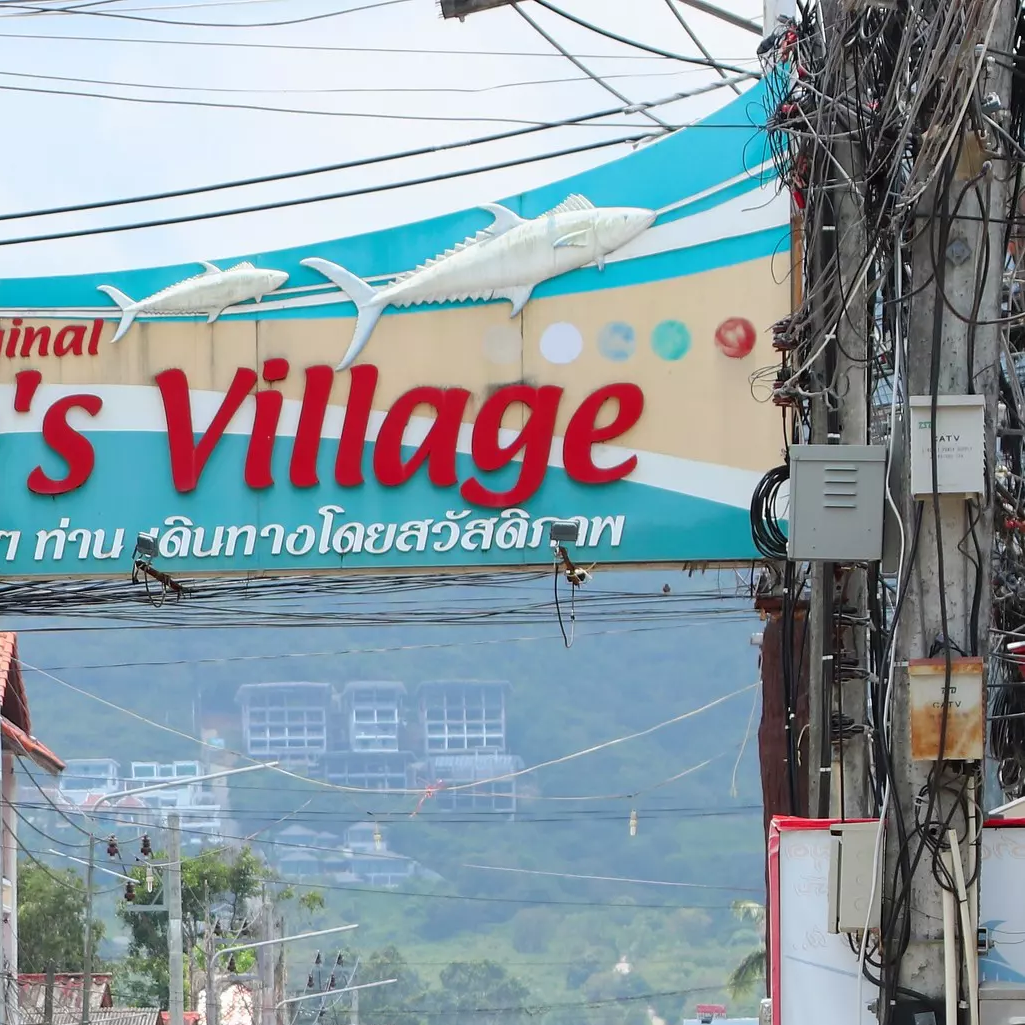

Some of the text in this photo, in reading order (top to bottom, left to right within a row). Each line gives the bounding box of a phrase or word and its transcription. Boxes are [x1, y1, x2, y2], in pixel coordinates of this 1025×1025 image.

[154, 357, 645, 508] Village
[33, 517, 125, 561] ท่าน
[146, 505, 626, 559] ดินทางโดยสวัสดิภาพ
